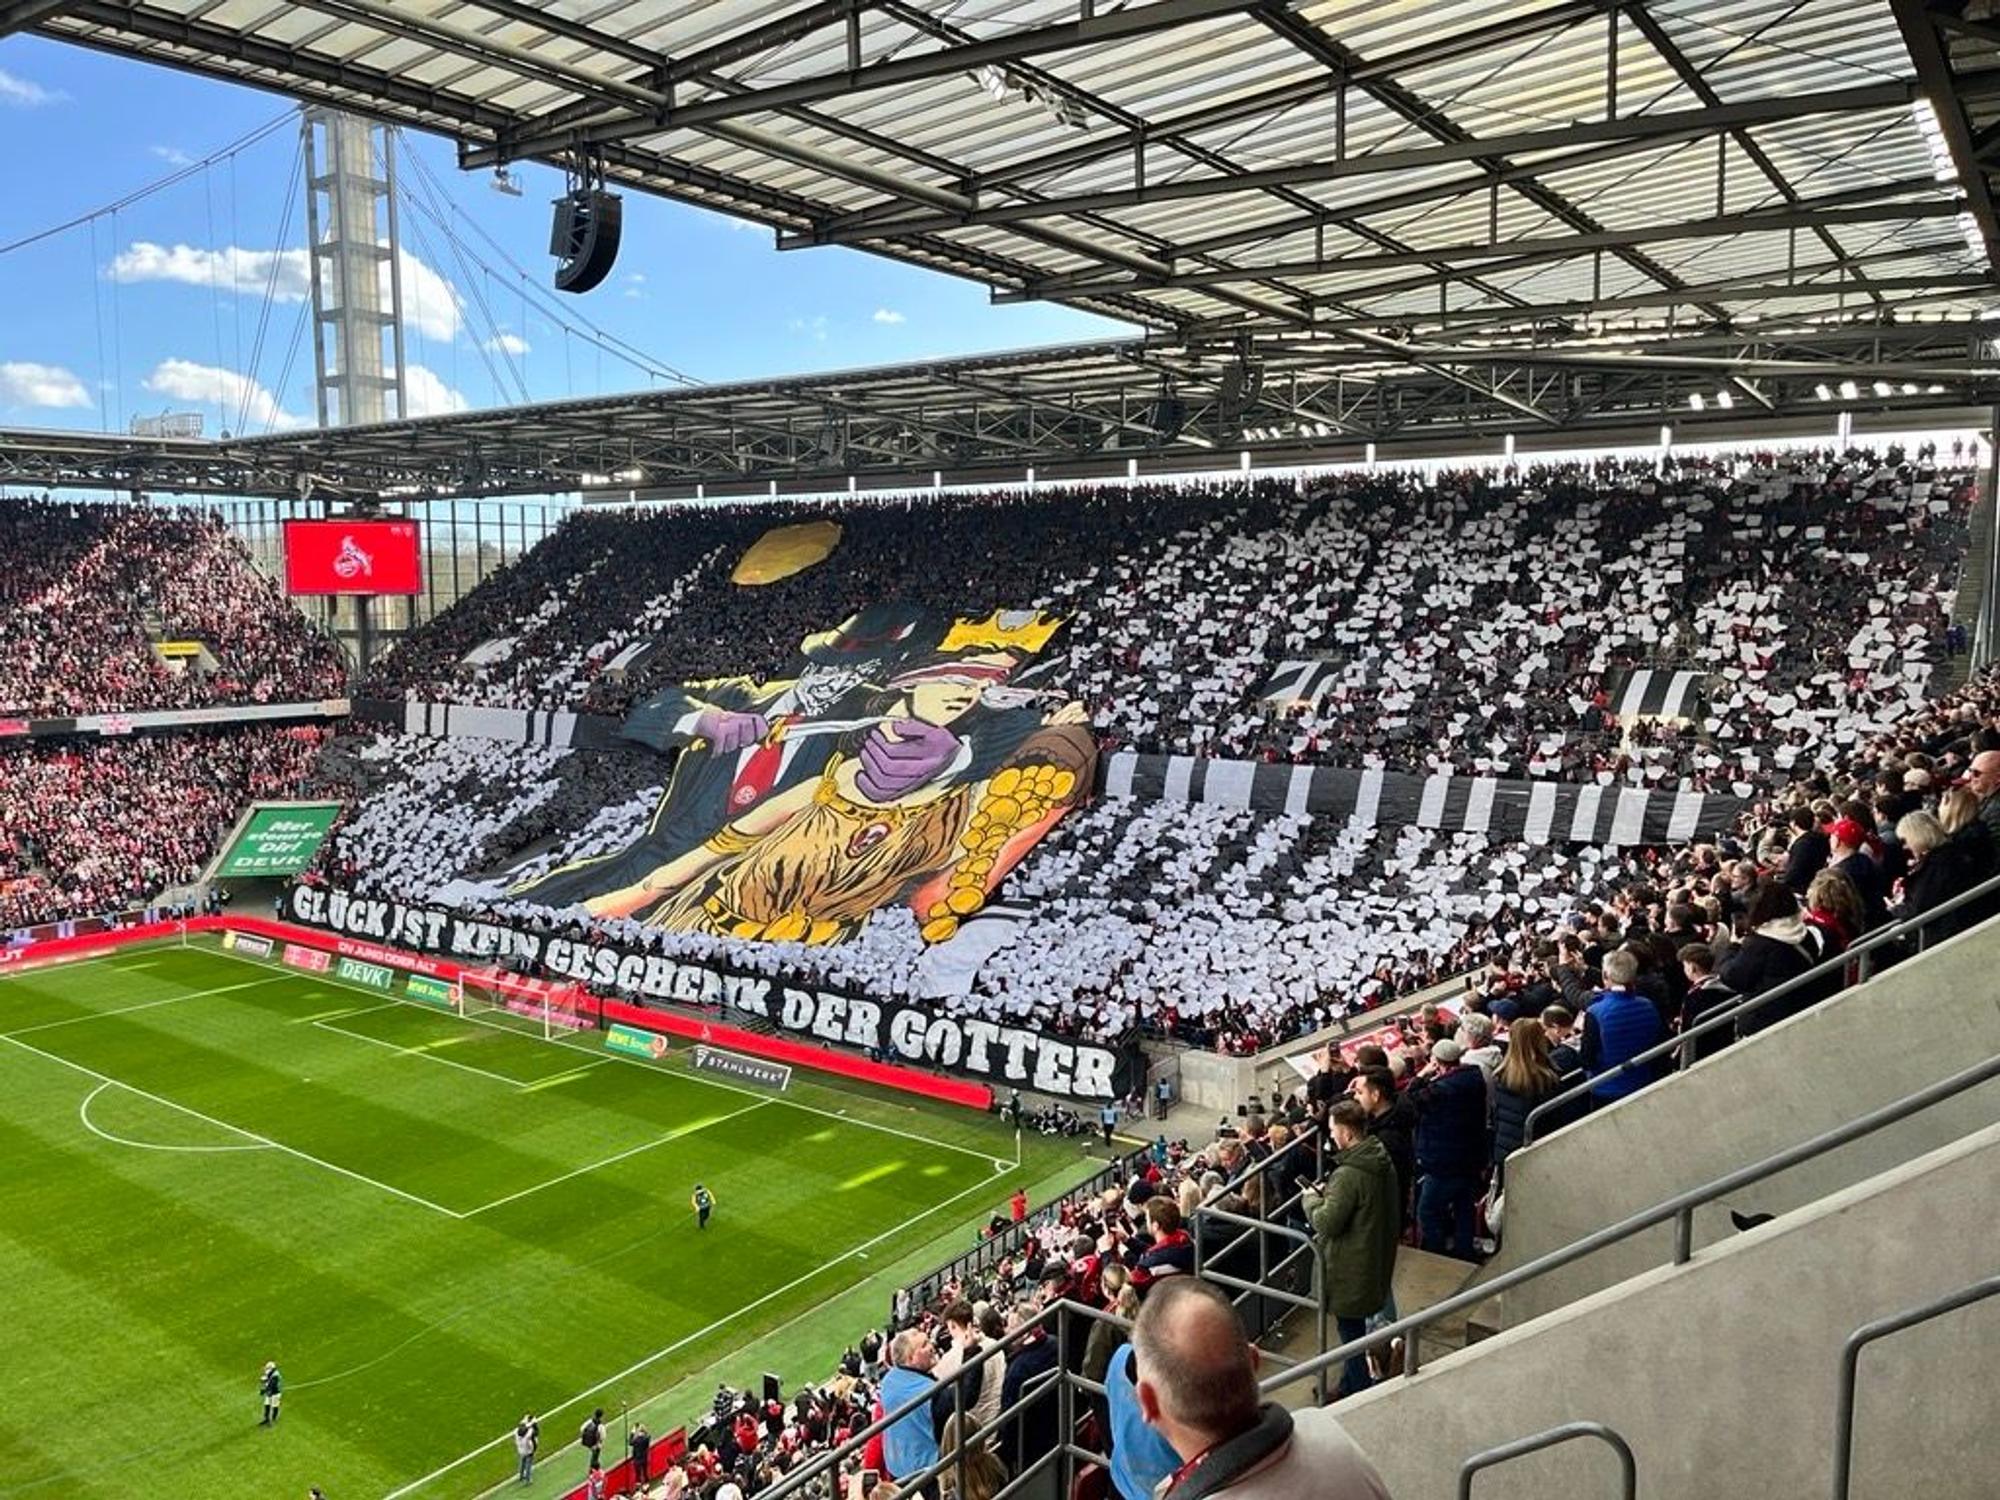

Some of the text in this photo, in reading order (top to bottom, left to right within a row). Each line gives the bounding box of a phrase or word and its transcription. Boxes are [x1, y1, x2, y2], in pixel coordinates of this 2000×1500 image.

[269, 820, 313, 832] Mer
[234, 856, 304, 867] DEVK
[342, 962, 386, 987] DEVK
[293, 884, 1117, 1099] GLÜCK IST KEIN GESCHENK DER GÖTTER
